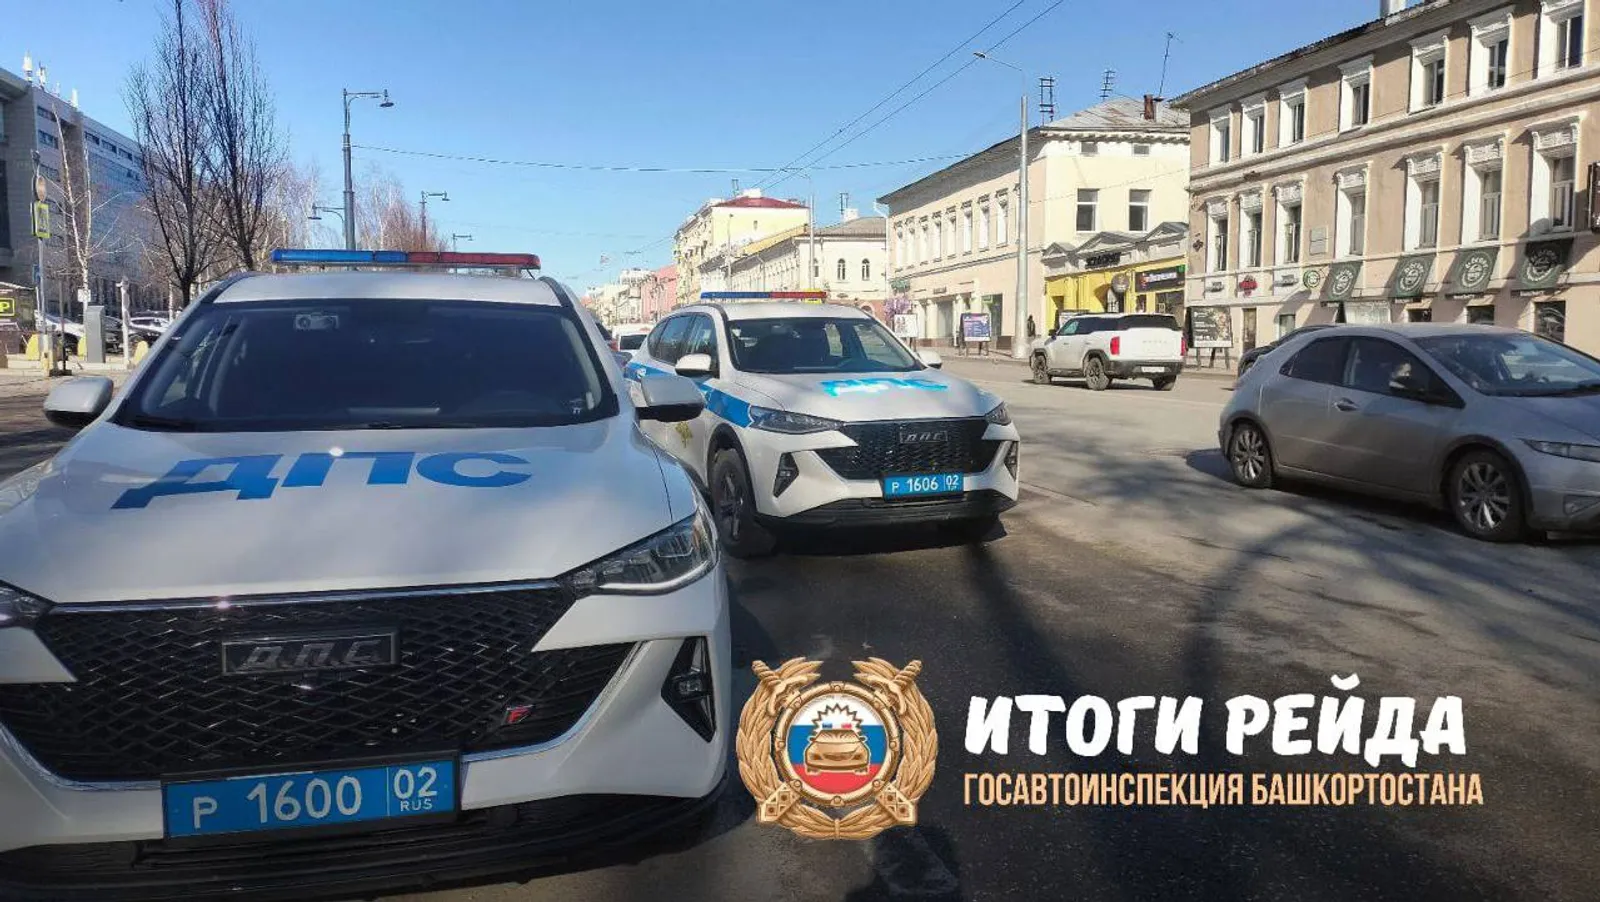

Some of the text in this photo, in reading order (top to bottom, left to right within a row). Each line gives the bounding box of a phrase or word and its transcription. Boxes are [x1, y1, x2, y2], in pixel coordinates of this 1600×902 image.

[110, 451, 531, 509] ДПС
[891, 474, 959, 494] Р 1606 02
[192, 766, 438, 830] Р 1600 02
[400, 798, 433, 812] RUS
